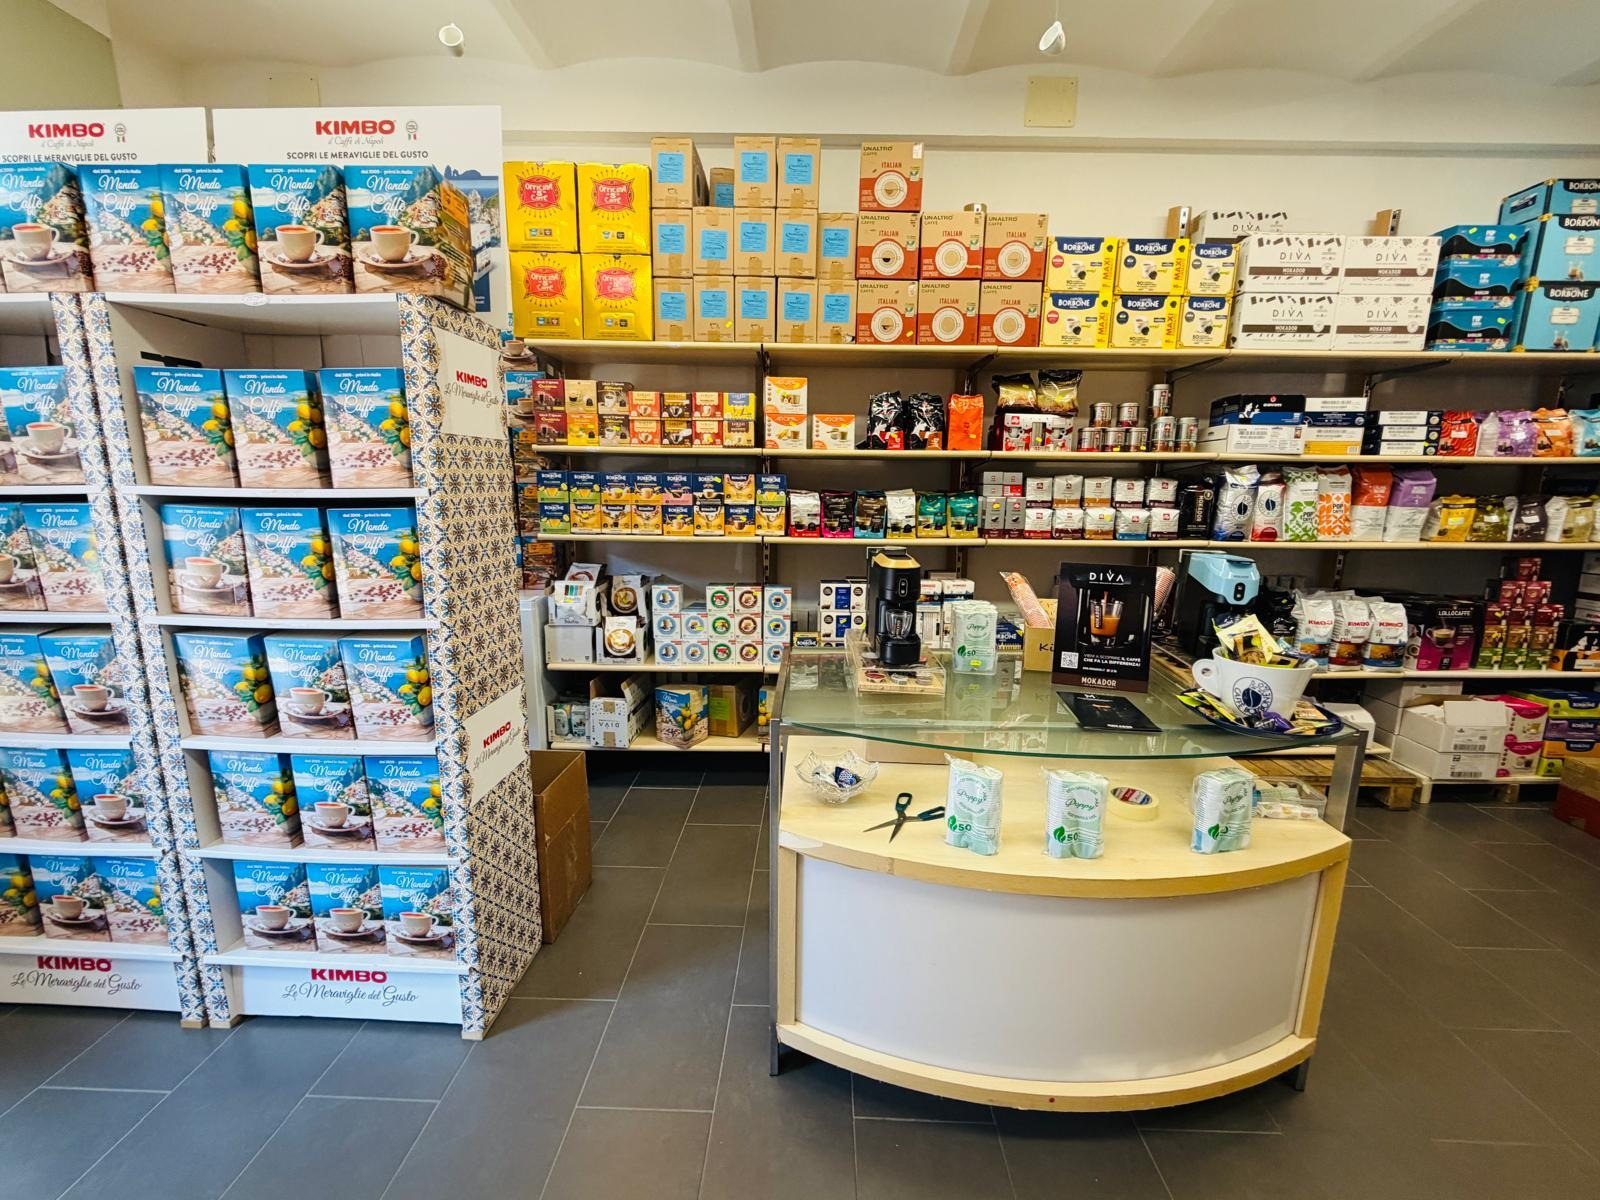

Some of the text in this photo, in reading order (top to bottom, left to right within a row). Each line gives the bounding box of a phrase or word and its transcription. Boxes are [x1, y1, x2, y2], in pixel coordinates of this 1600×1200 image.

[28, 123, 104, 138] KIMBO
[315, 120, 395, 136] KIMBO
[2, 152, 138, 163] SCOPRI LE MERAVIGLIE DEL GUSTO
[287, 150, 429, 160] SCOPRI LE MERAVIGLIE DEL GUSTO
[98, 175, 140, 190] Mondo
[179, 175, 221, 190] Mondo
[271, 174, 314, 190] Mondo
[366, 176, 411, 191] Mondo
[1063, 243, 1095, 252] BORBONE
[1135, 244, 1167, 252] BORBONE
[1200, 248, 1228, 256] BORBONE
[1279, 251, 1311, 260] DIVA
[1376, 252, 1407, 262] DIVA
[1103, 258, 1111, 280] MAXI
[1174, 257, 1182, 281] MAXI
[1550, 289, 1589, 298] BORBONE
[1058, 299, 1090, 307] BORBONE
[1127, 300, 1159, 308] BORBONE
[1192, 301, 1222, 309] BORBONE
[1272, 308, 1303, 317] DIVA
[1367, 309, 1398, 319] DIVA
[1097, 312, 1105, 335] MAXI
[1165, 312, 1174, 336] MAXI
[17, 377, 58, 391] Mondo
[157, 378, 200, 392] Mondo
[339, 378, 379, 392] Mondo
[456, 370, 487, 388] KIMBO
[245, 380, 286, 394] Mondo
[42, 514, 78, 527] Mondo
[181, 515, 222, 529] Mondo
[261, 518, 300, 531] Mondo
[348, 519, 389, 532] Mondo
[1089, 571, 1124, 582] DIVA
[61, 646, 98, 658] Mondo
[194, 645, 232, 658] Mondo
[284, 648, 321, 661] Mondo
[359, 649, 395, 661] Mondo
[1081, 677, 1116, 686] MOKADOR
[483, 721, 511, 748] KIMBO
[85, 757, 120, 769] Mondo
[227, 760, 262, 773] Mondo
[309, 764, 346, 776] Mondo
[384, 764, 420, 777] Mondo
[957, 788, 983, 805] Poppy
[1065, 798, 1094, 811] Poppy
[958, 823, 972, 832] 50
[1067, 834, 1079, 842] 50
[251, 870, 287, 882] Mondo
[325, 872, 362, 884] Mondo
[396, 875, 431, 889] Mondo
[37, 956, 112, 972] KIMBO
[27, 970, 92, 992] Meraviglie
[93, 978, 107, 988] del
[107, 974, 142, 995] Gusto
[311, 968, 387, 984] KIMBO
[298, 982, 367, 1004] Meraviglie
[367, 990, 382, 1000] del
[382, 985, 418, 1006] Gusto
